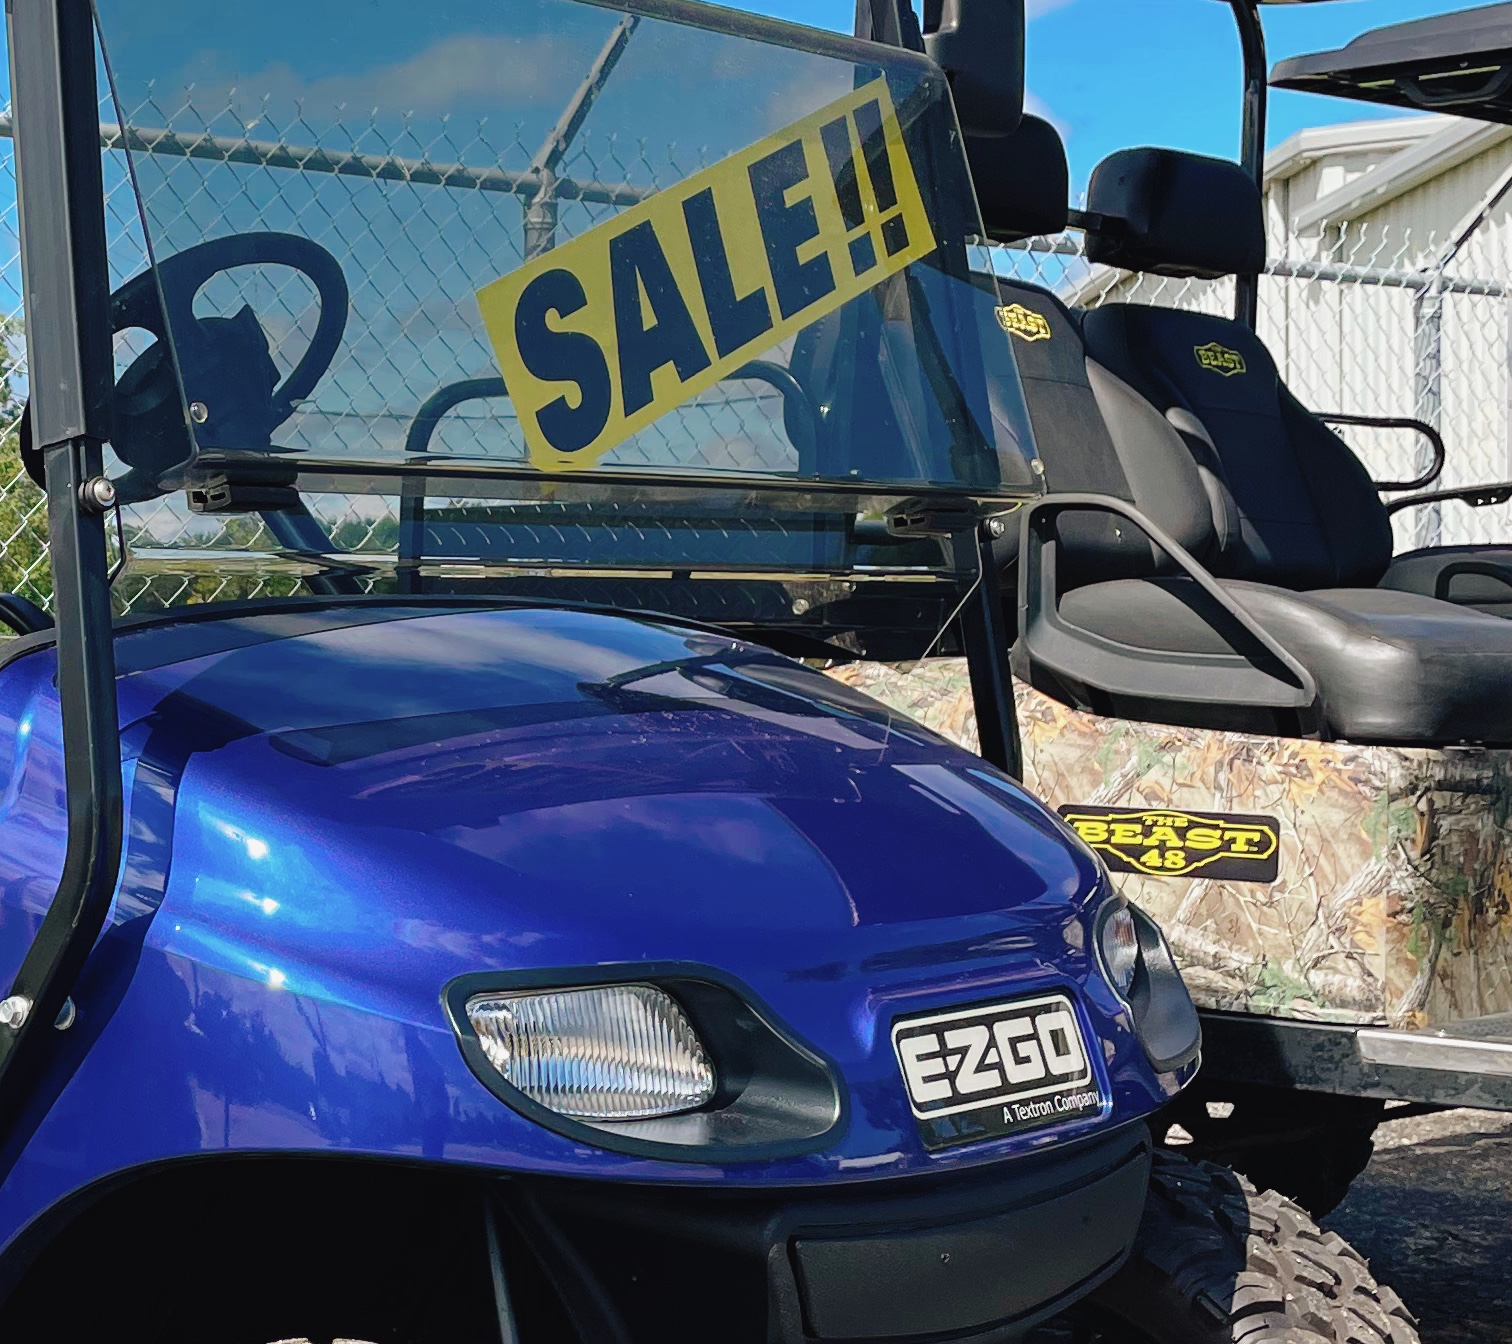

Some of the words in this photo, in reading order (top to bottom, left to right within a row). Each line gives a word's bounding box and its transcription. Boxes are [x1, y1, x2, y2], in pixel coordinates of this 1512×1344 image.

[514, 97, 911, 453] SALE!!
[1072, 821, 1261, 853] BEAST
[1142, 815, 1189, 828] THE
[1139, 848, 1187, 869] 48
[1003, 1106, 1014, 1124] A
[1011, 1100, 1054, 1121] Textron
[1054, 1090, 1100, 1112] Company
